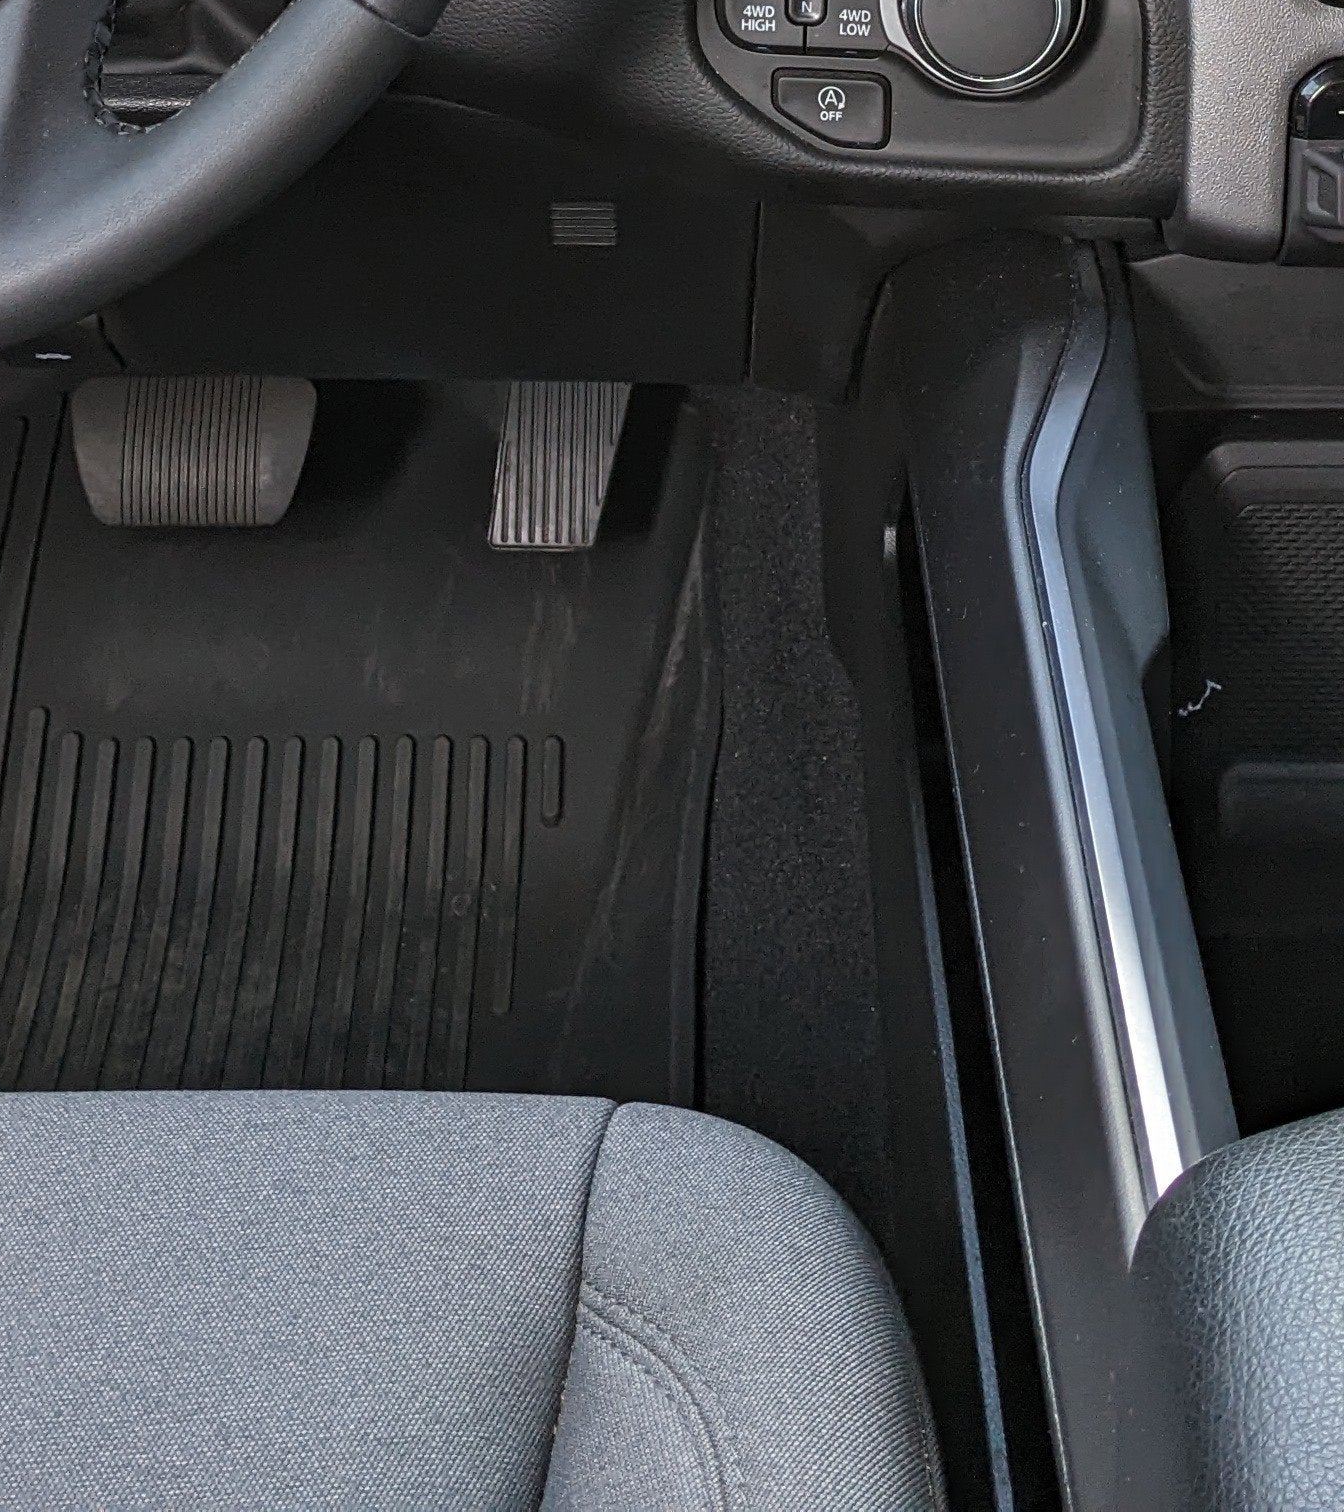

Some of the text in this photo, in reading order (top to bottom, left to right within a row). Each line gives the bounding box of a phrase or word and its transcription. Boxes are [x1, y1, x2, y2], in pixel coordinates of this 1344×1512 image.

[742, 5, 775, 19] 4WD
[801, 0, 812, 13] N
[839, 9, 871, 23] 4WD
[741, 18, 776, 33] HIGH
[839, 22, 871, 37] LOW
[820, 110, 843, 122] OFF
